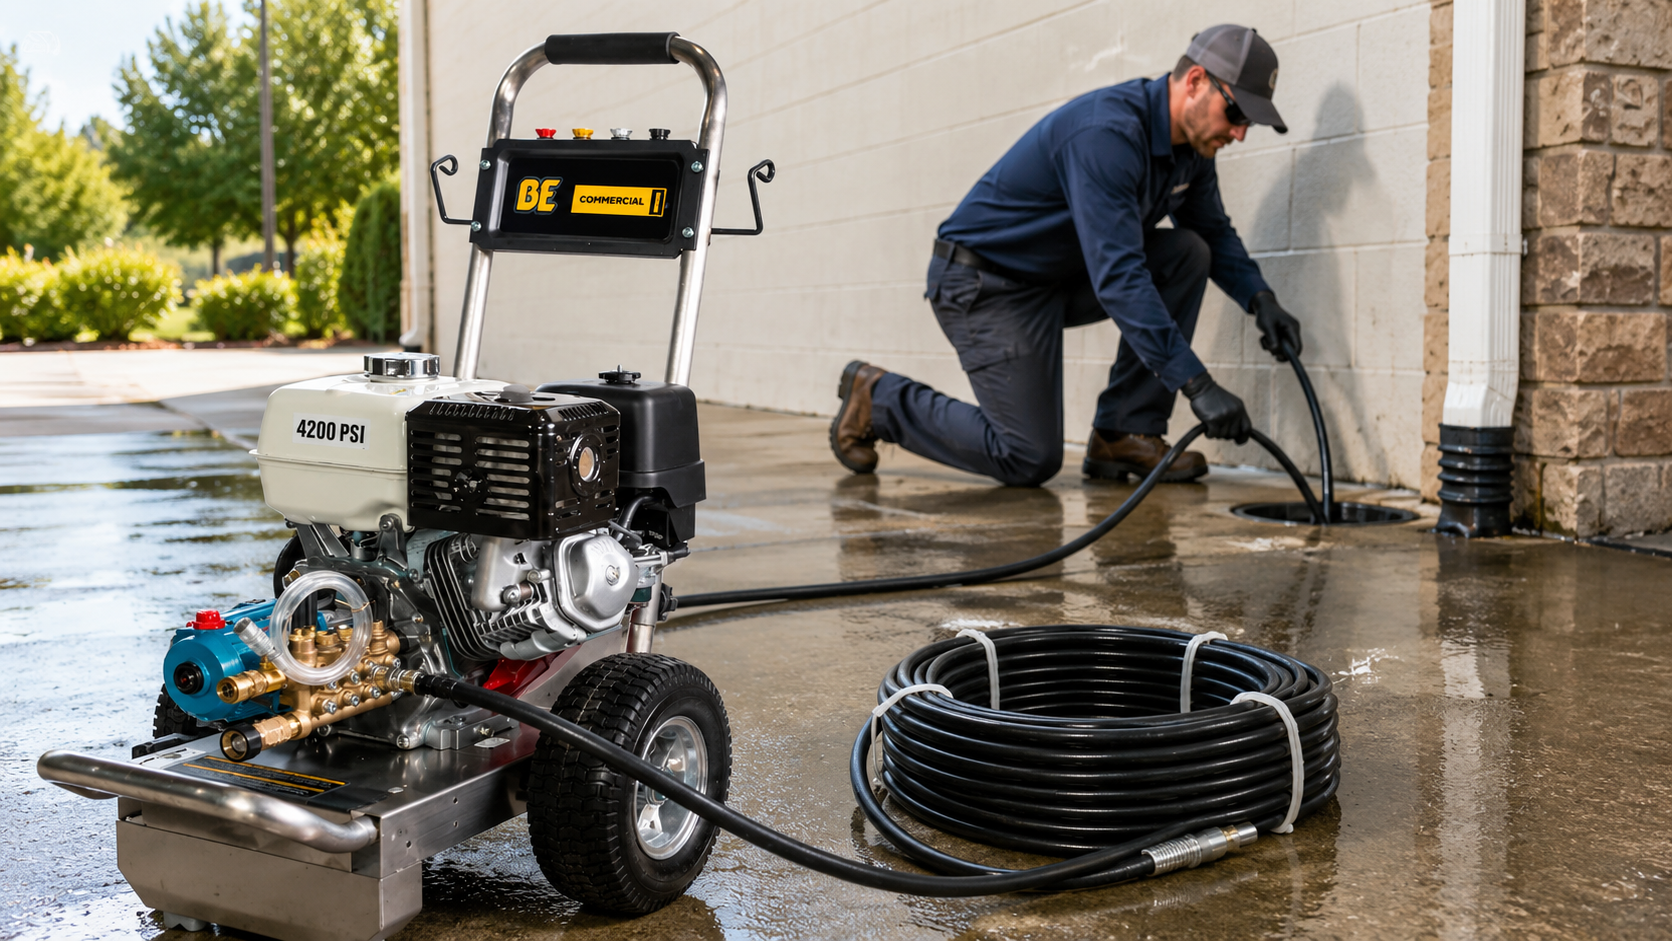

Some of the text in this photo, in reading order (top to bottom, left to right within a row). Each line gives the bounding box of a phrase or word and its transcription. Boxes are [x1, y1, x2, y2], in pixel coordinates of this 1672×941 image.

[515, 177, 645, 214] BE COMMERCIAL
[296, 419, 365, 444] 4200 PSI
